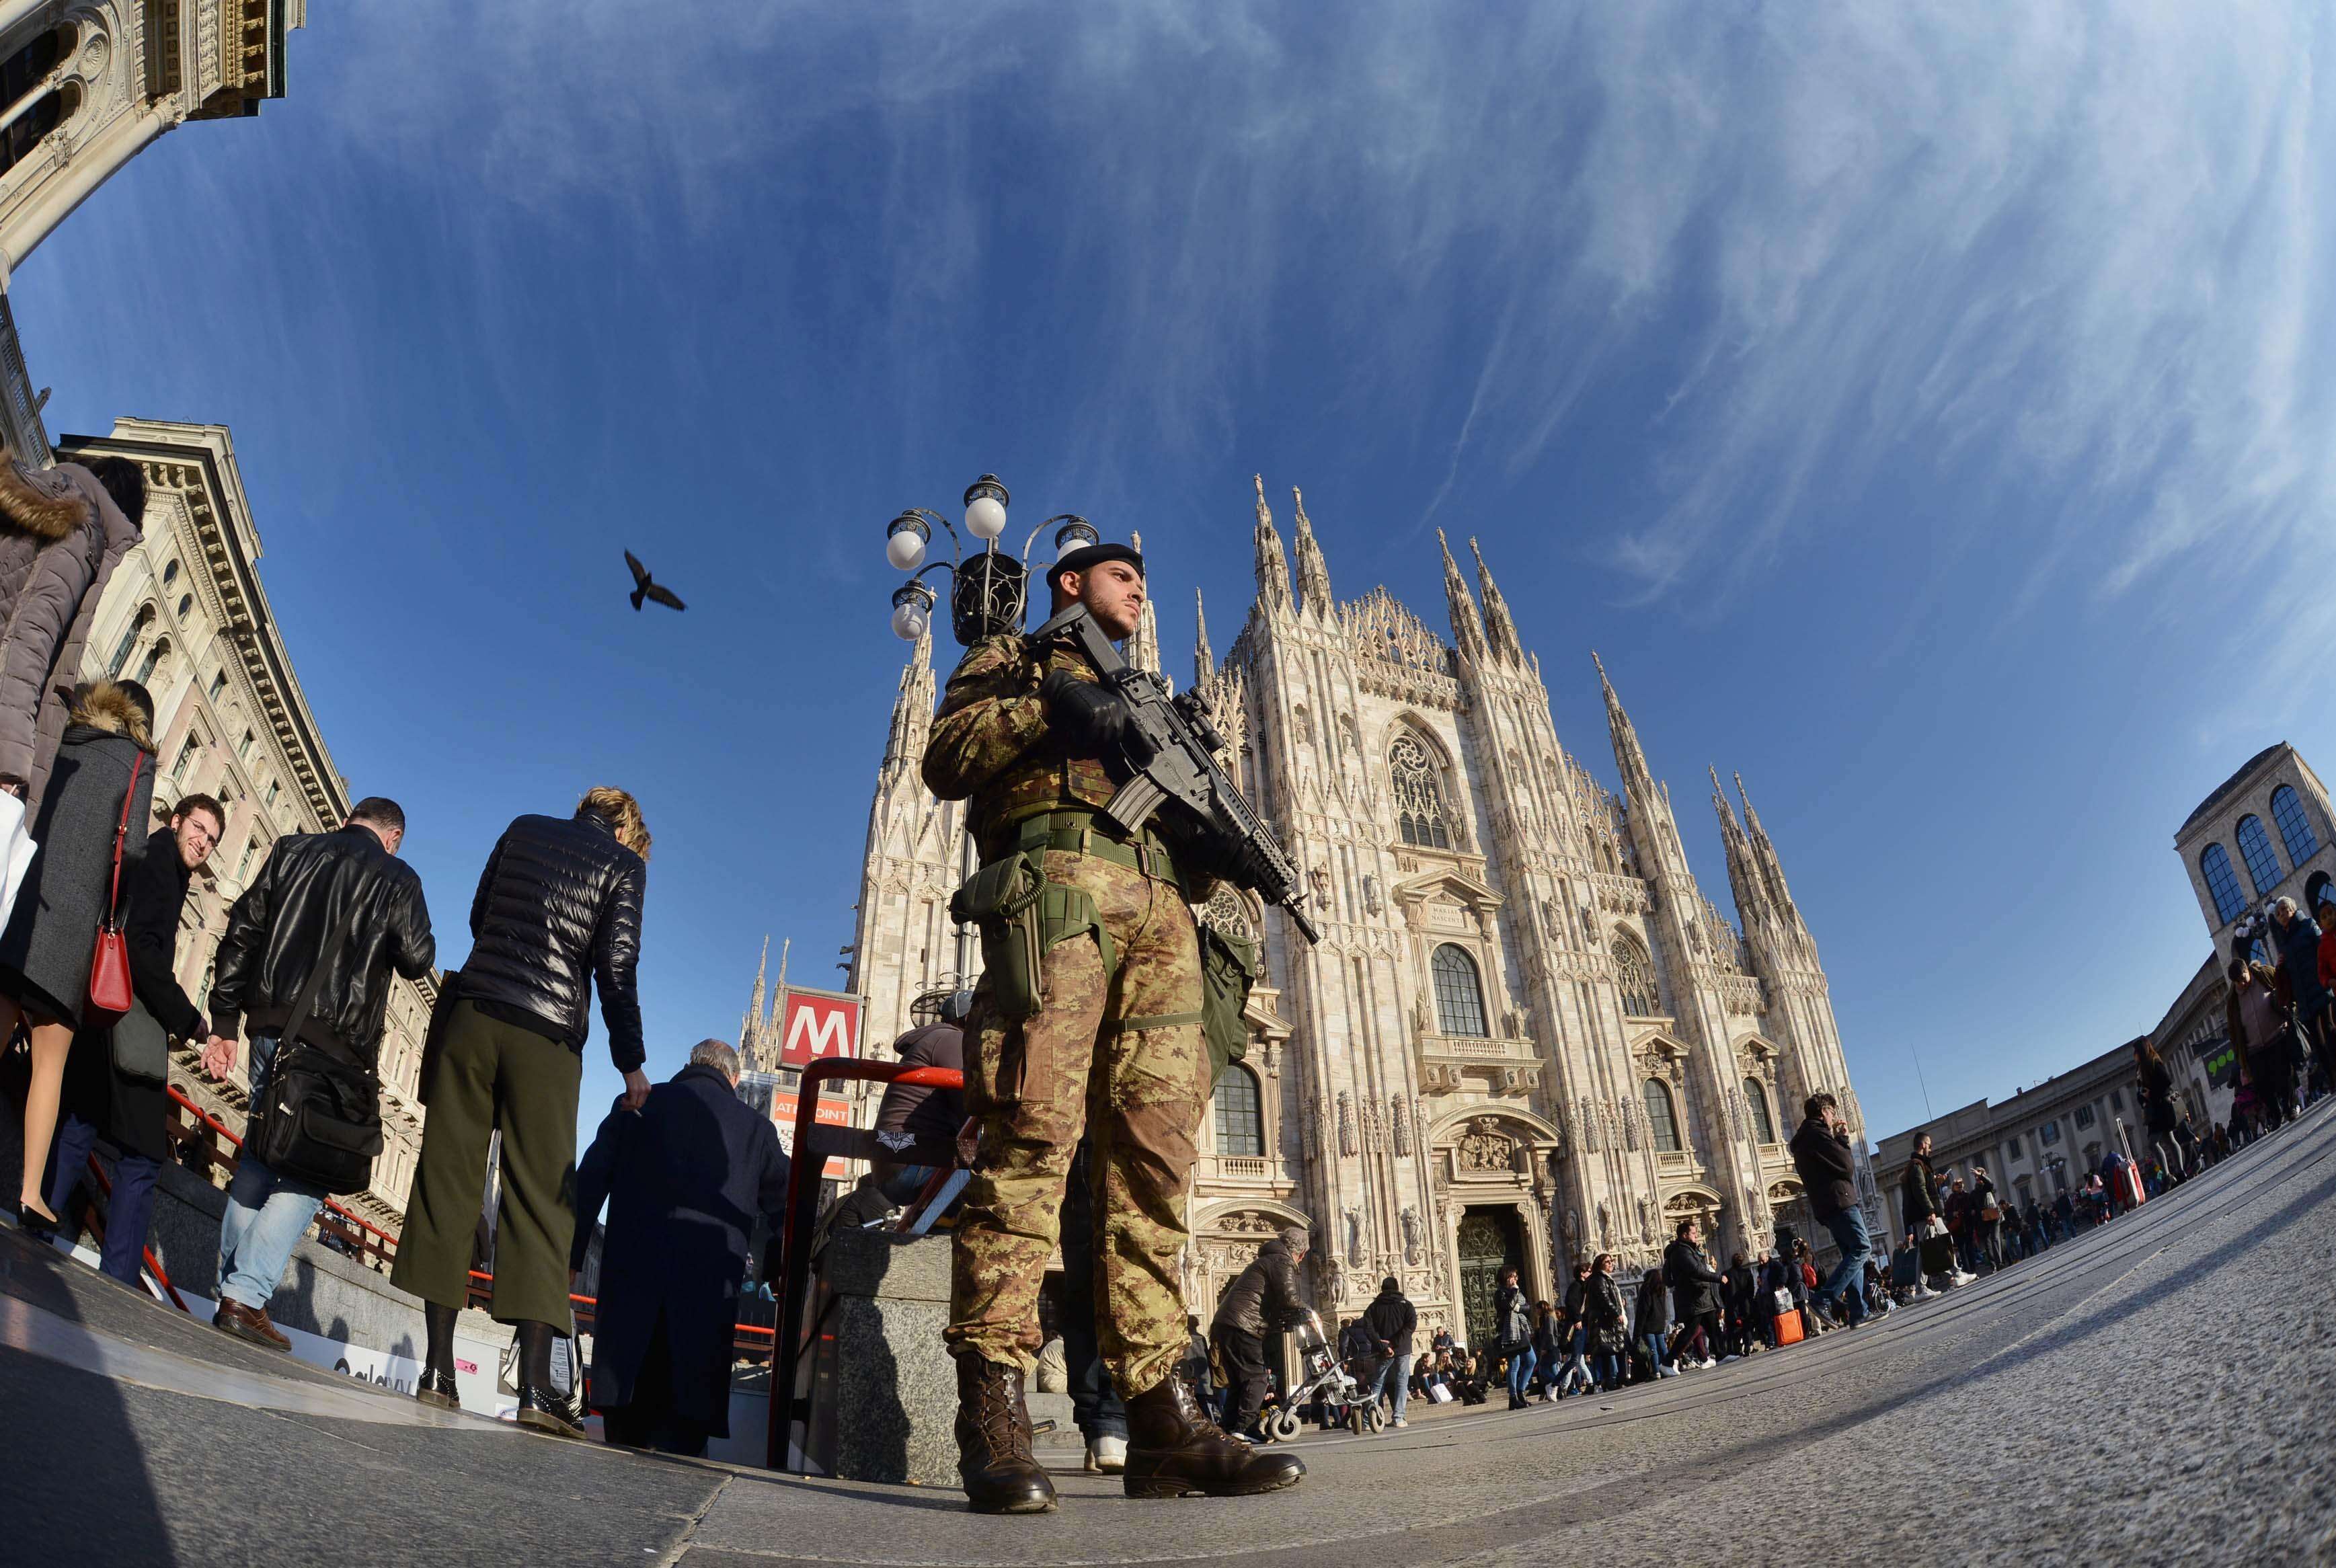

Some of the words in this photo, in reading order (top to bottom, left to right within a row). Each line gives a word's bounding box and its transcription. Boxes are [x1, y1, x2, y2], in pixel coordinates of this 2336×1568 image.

[1432, 906, 1458, 915] MARIAE
[1431, 914, 1463, 924] NASCENTI
[785, 1005, 850, 1058] M
[776, 1103, 797, 1115] AT
[816, 1108, 848, 1122] OINT
